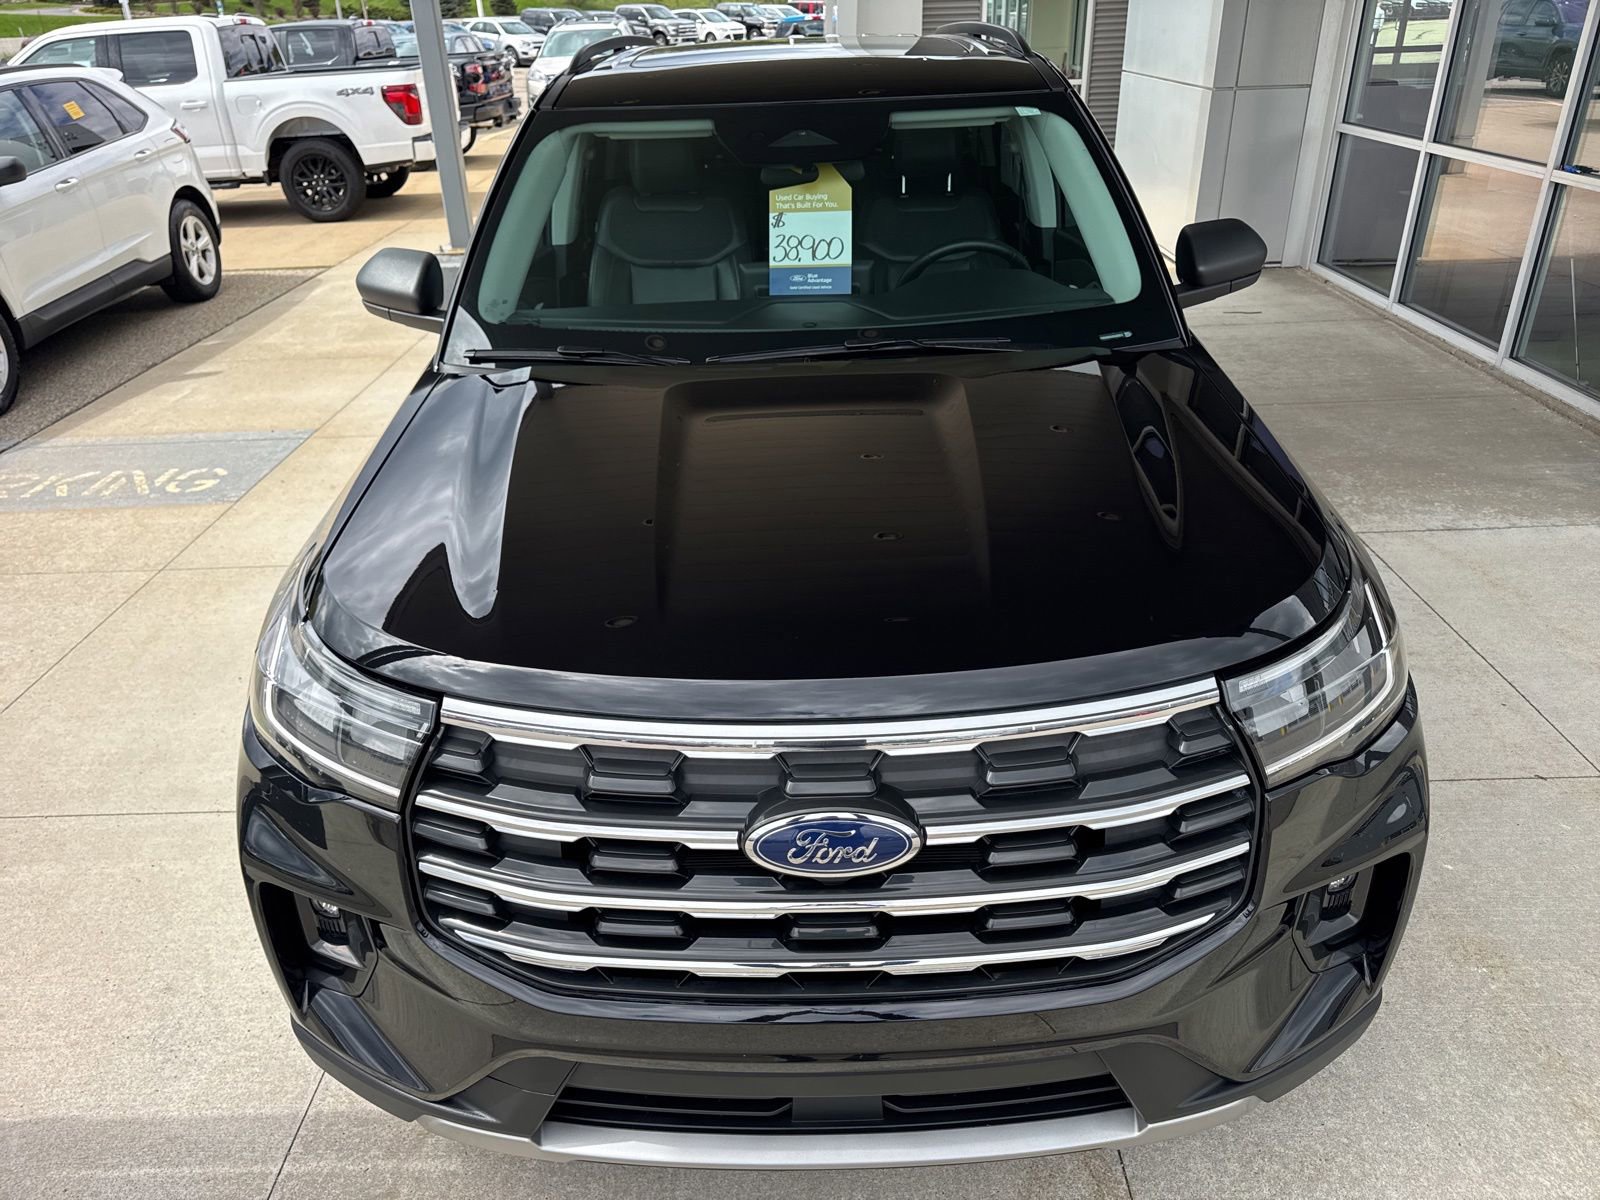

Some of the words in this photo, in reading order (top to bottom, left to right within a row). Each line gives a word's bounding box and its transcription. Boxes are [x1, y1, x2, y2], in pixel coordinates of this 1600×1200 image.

[775, 193, 792, 201] Used
[793, 193, 804, 201] Car
[805, 193, 828, 202] Buying
[787, 829, 879, 864] Ford
